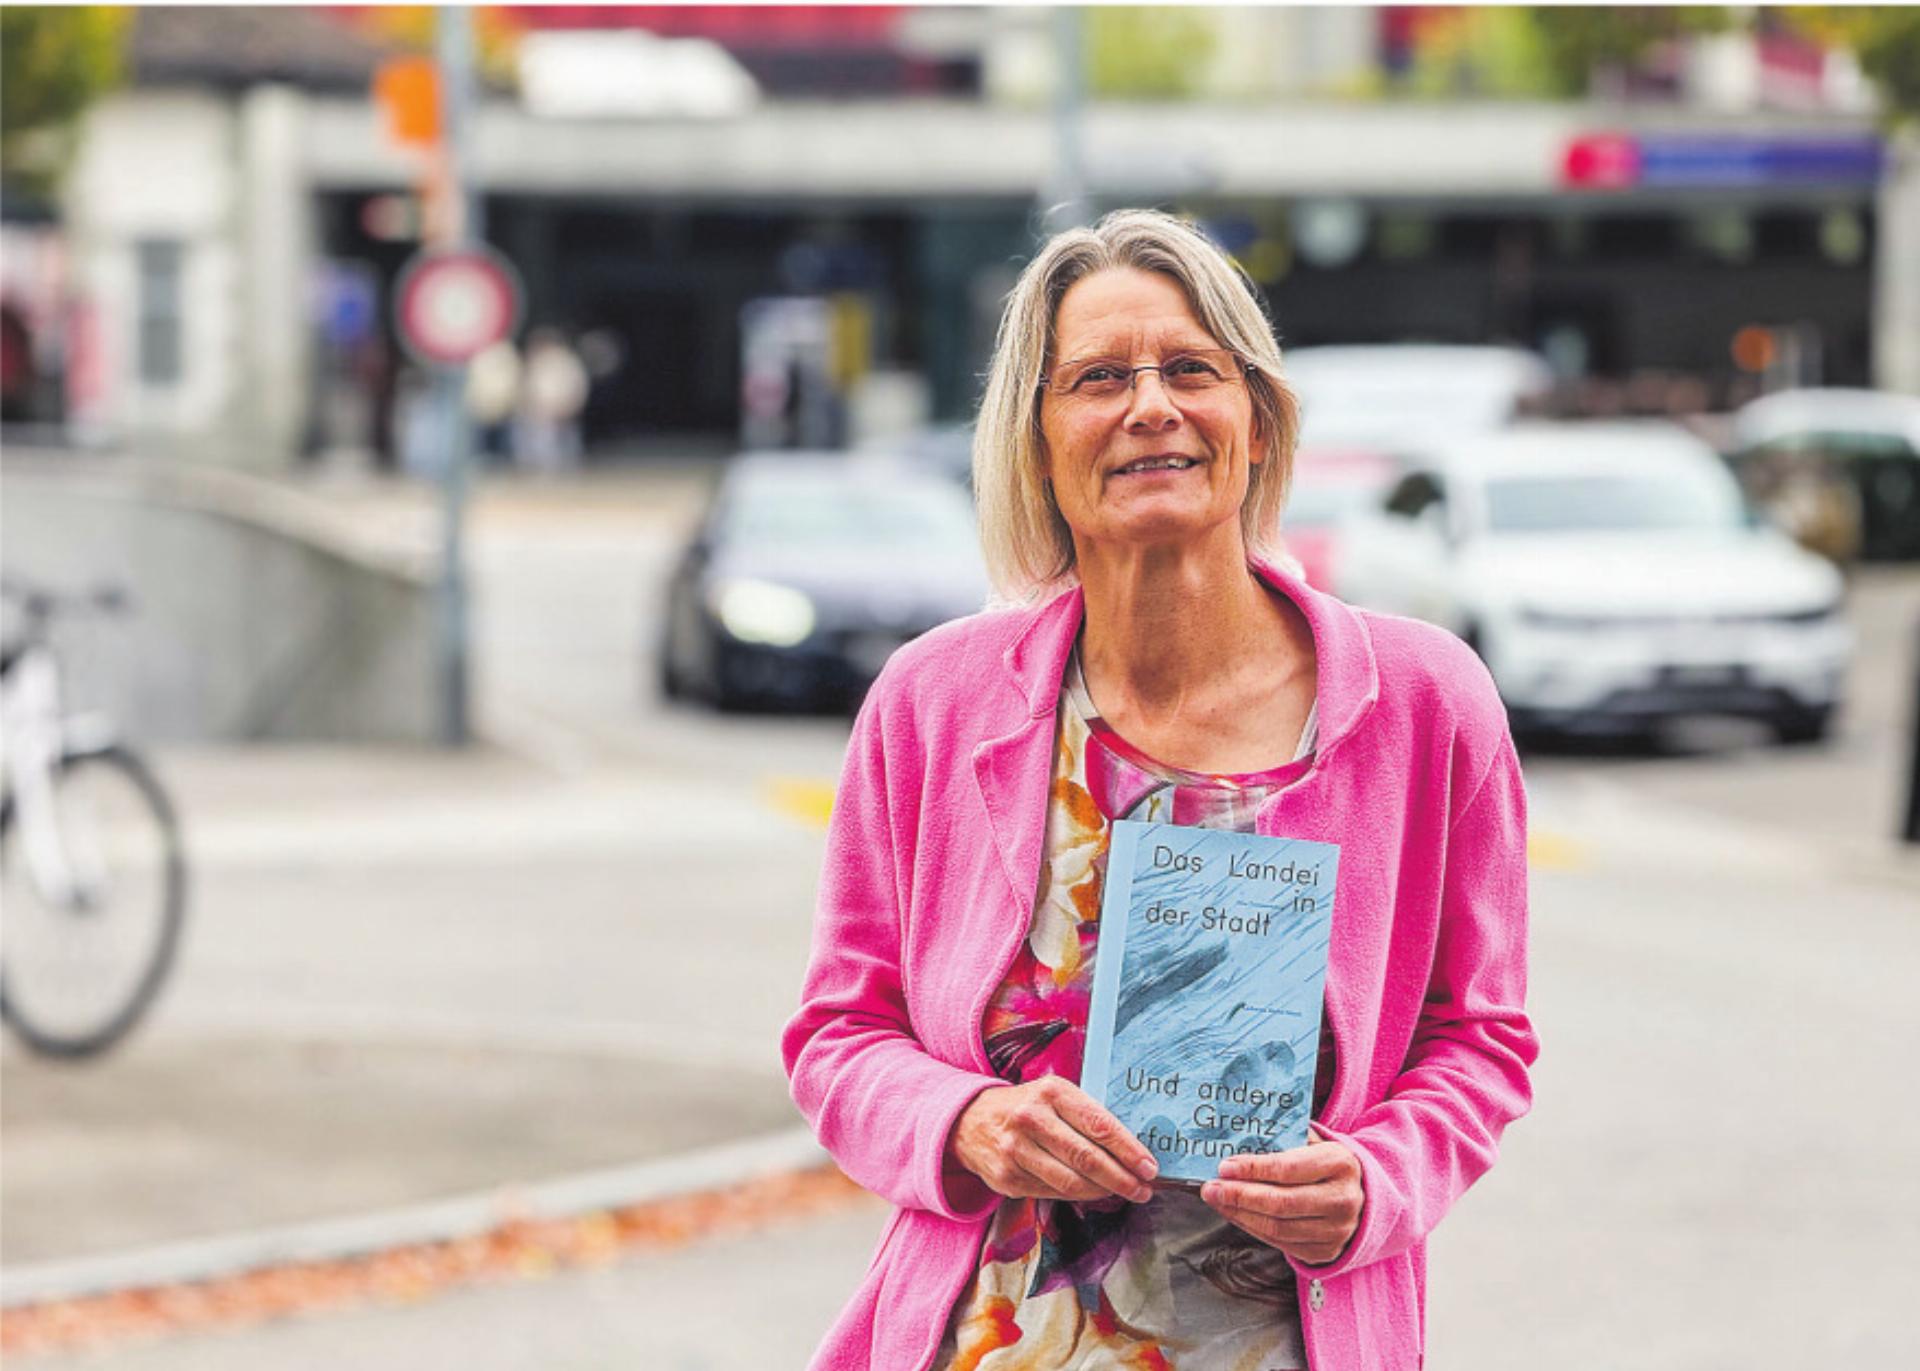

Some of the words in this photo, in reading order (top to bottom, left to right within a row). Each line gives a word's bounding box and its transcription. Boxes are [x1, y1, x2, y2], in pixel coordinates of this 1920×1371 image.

[1154, 845, 1203, 873] Das
[1229, 854, 1320, 886] Landei
[1145, 901, 1190, 926] der
[1201, 906, 1271, 936] Stadt
[1293, 889, 1316, 913] in
[1126, 1067, 1179, 1096] Und
[1198, 1080, 1293, 1110] andere
[1193, 1104, 1290, 1137] Grenz-
